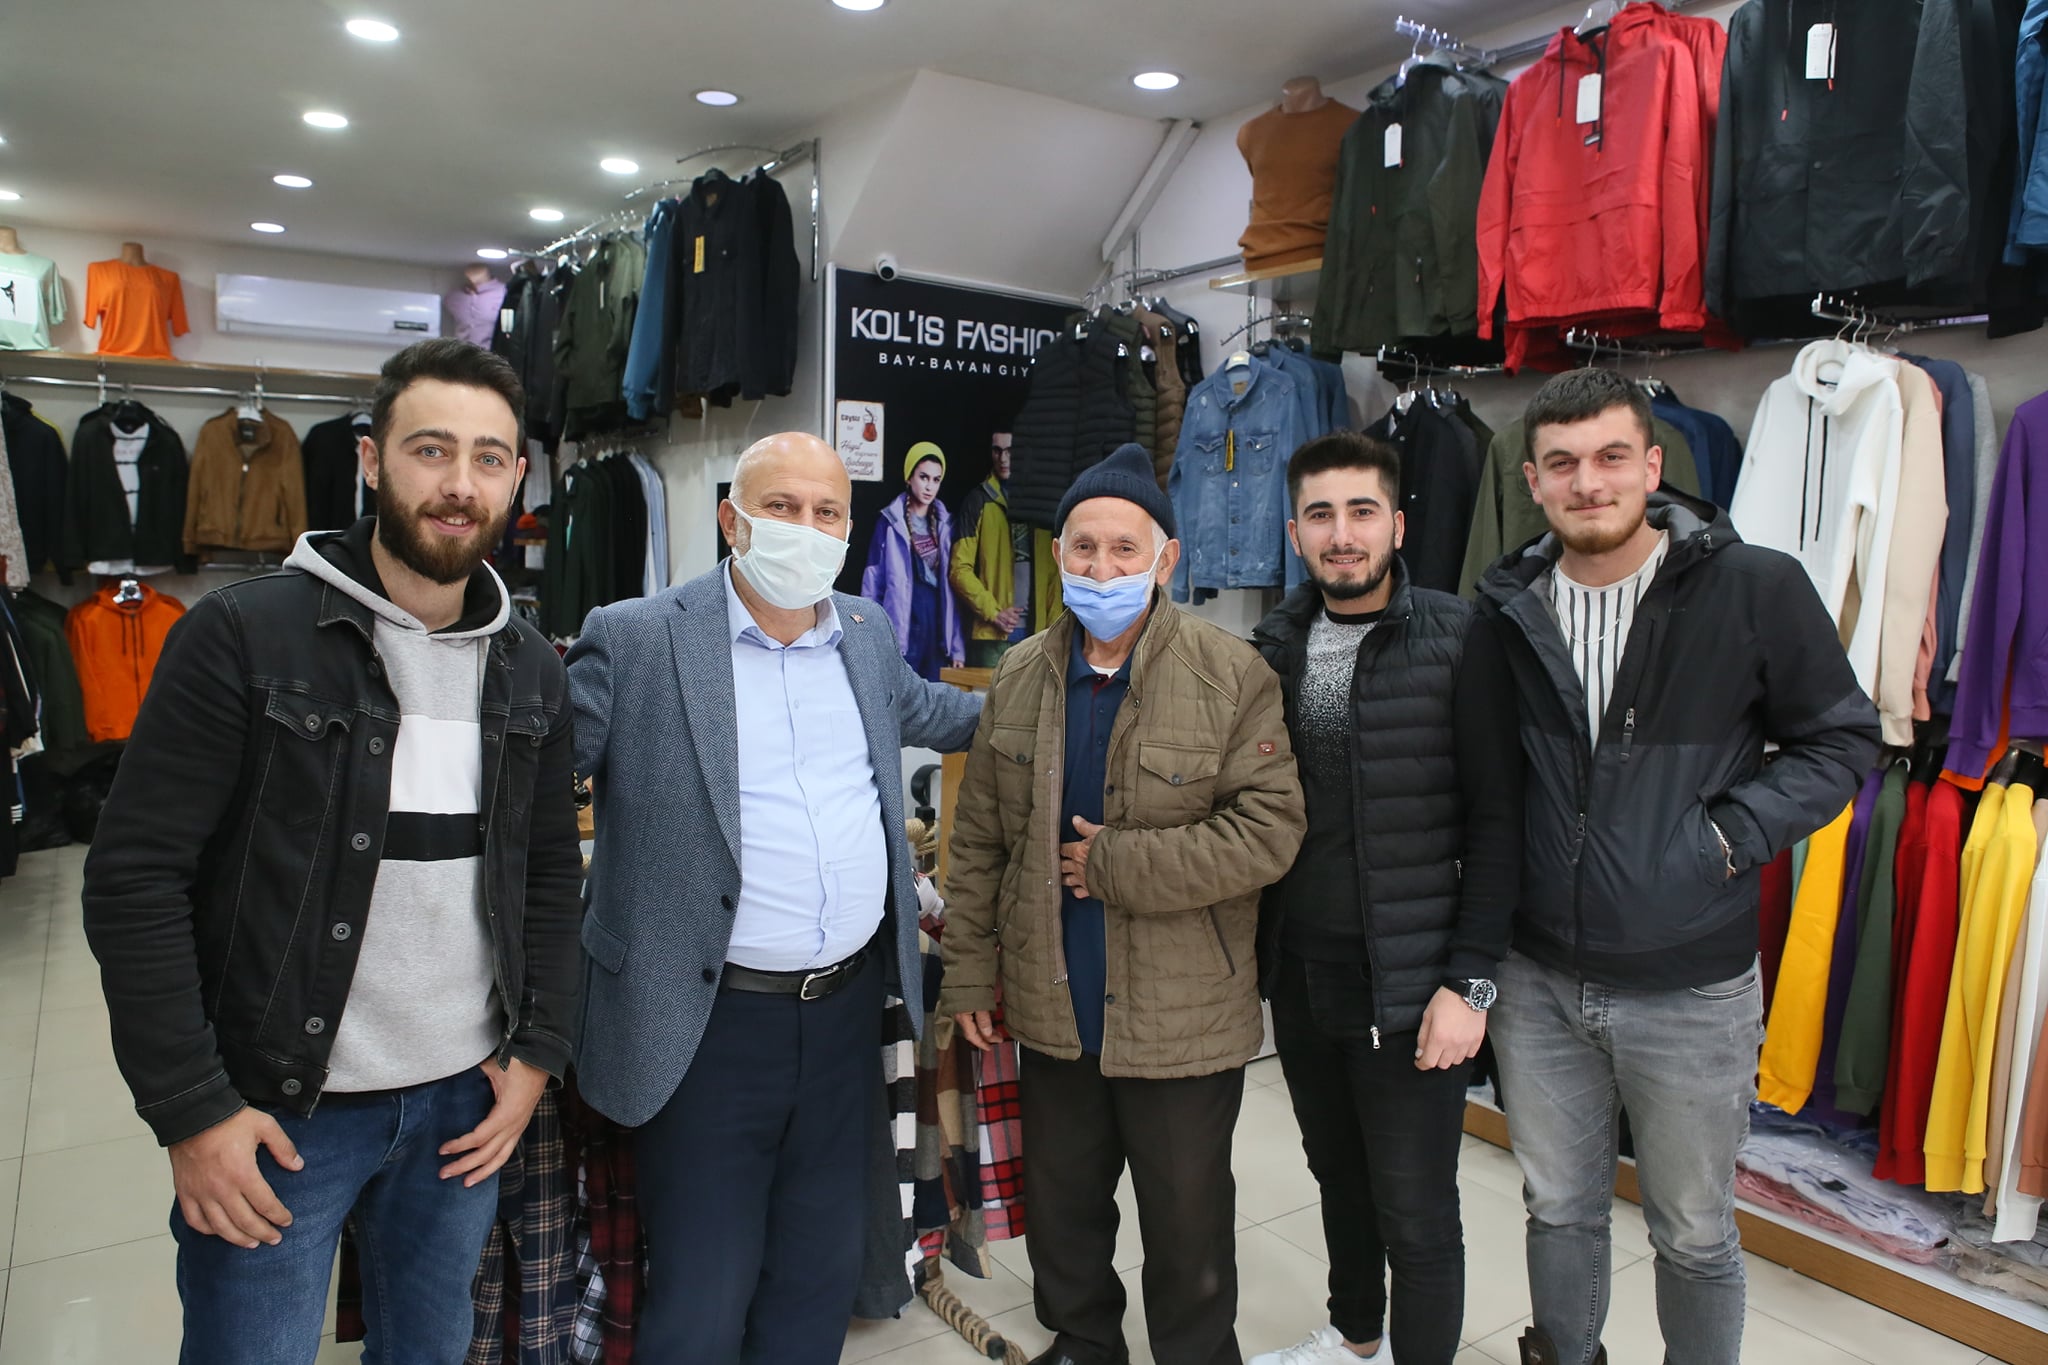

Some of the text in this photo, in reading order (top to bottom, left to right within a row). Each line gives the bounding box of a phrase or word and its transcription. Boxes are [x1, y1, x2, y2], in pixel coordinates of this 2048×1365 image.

[851, 306, 1063, 356] KOL'IS FASHIO
[878, 352, 991, 374] BAY-BAYAN
